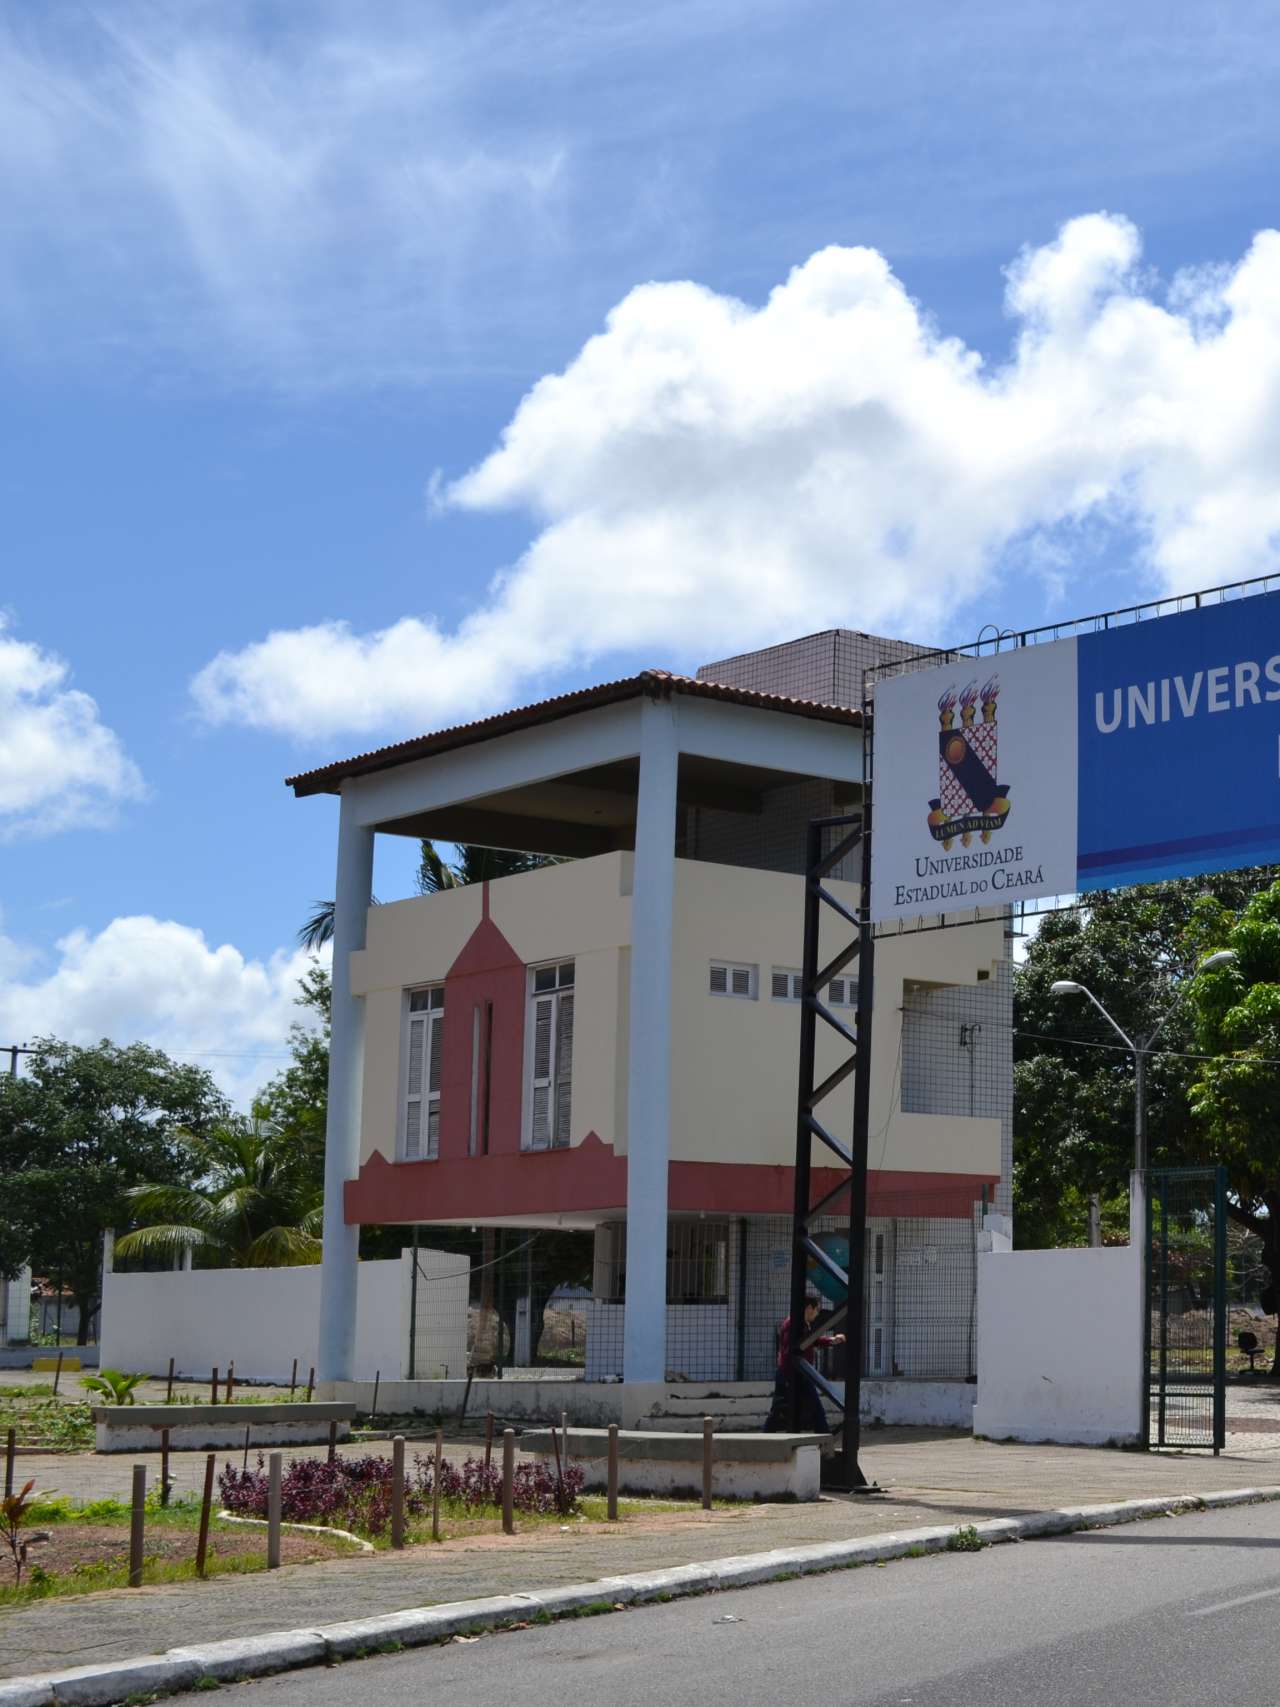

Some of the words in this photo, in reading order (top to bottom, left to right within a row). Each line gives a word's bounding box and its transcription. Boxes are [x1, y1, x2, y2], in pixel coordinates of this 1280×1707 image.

[914, 846, 1024, 878] UNIVERSIDADE
[895, 881, 968, 906] ESTADUAL
[970, 879, 989, 894] DO
[991, 865, 1044, 890] CEARÁ
